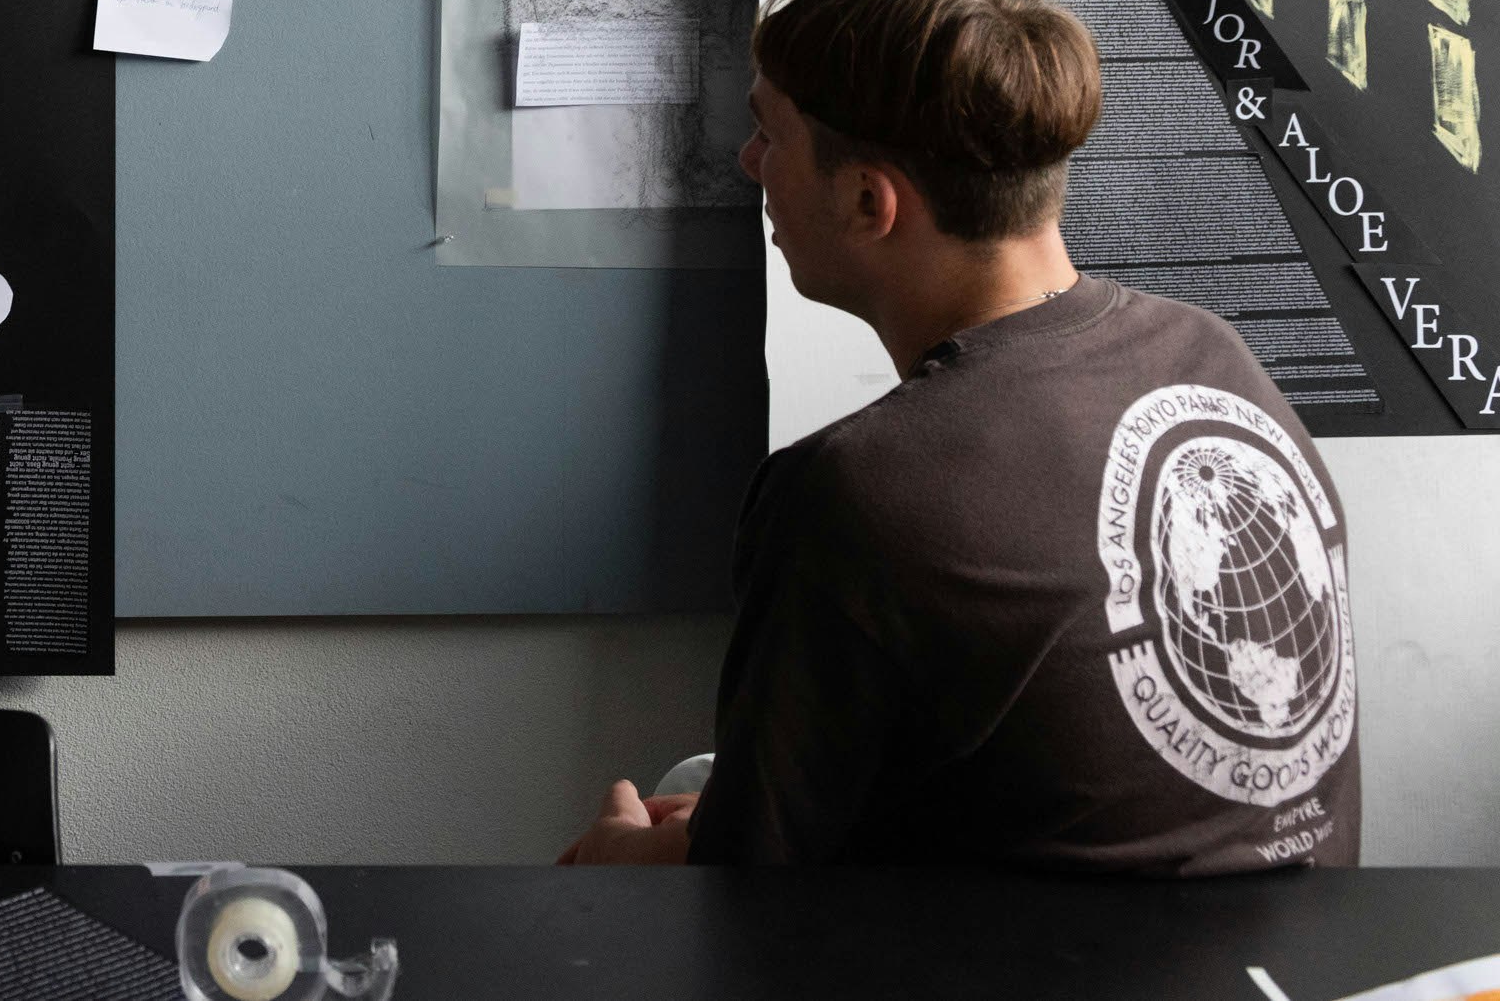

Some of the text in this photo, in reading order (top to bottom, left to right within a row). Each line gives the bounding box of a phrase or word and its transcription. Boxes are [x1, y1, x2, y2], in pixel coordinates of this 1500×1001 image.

[1235, 87, 1266, 120] &
[1279, 113, 1388, 252] ALOE
[1130, 400, 1178, 443] TOKYO
[1180, 395, 1232, 418] PARIS
[1235, 404, 1283, 444] NEW
[1108, 436, 1141, 550] ANGELES
[1291, 446, 1326, 508] YORK
[1114, 558, 1134, 606] LOS
[1132, 674, 1227, 776] QUALITY
[1230, 749, 1311, 792] GOODS
[1255, 830, 1314, 864] WORLD
